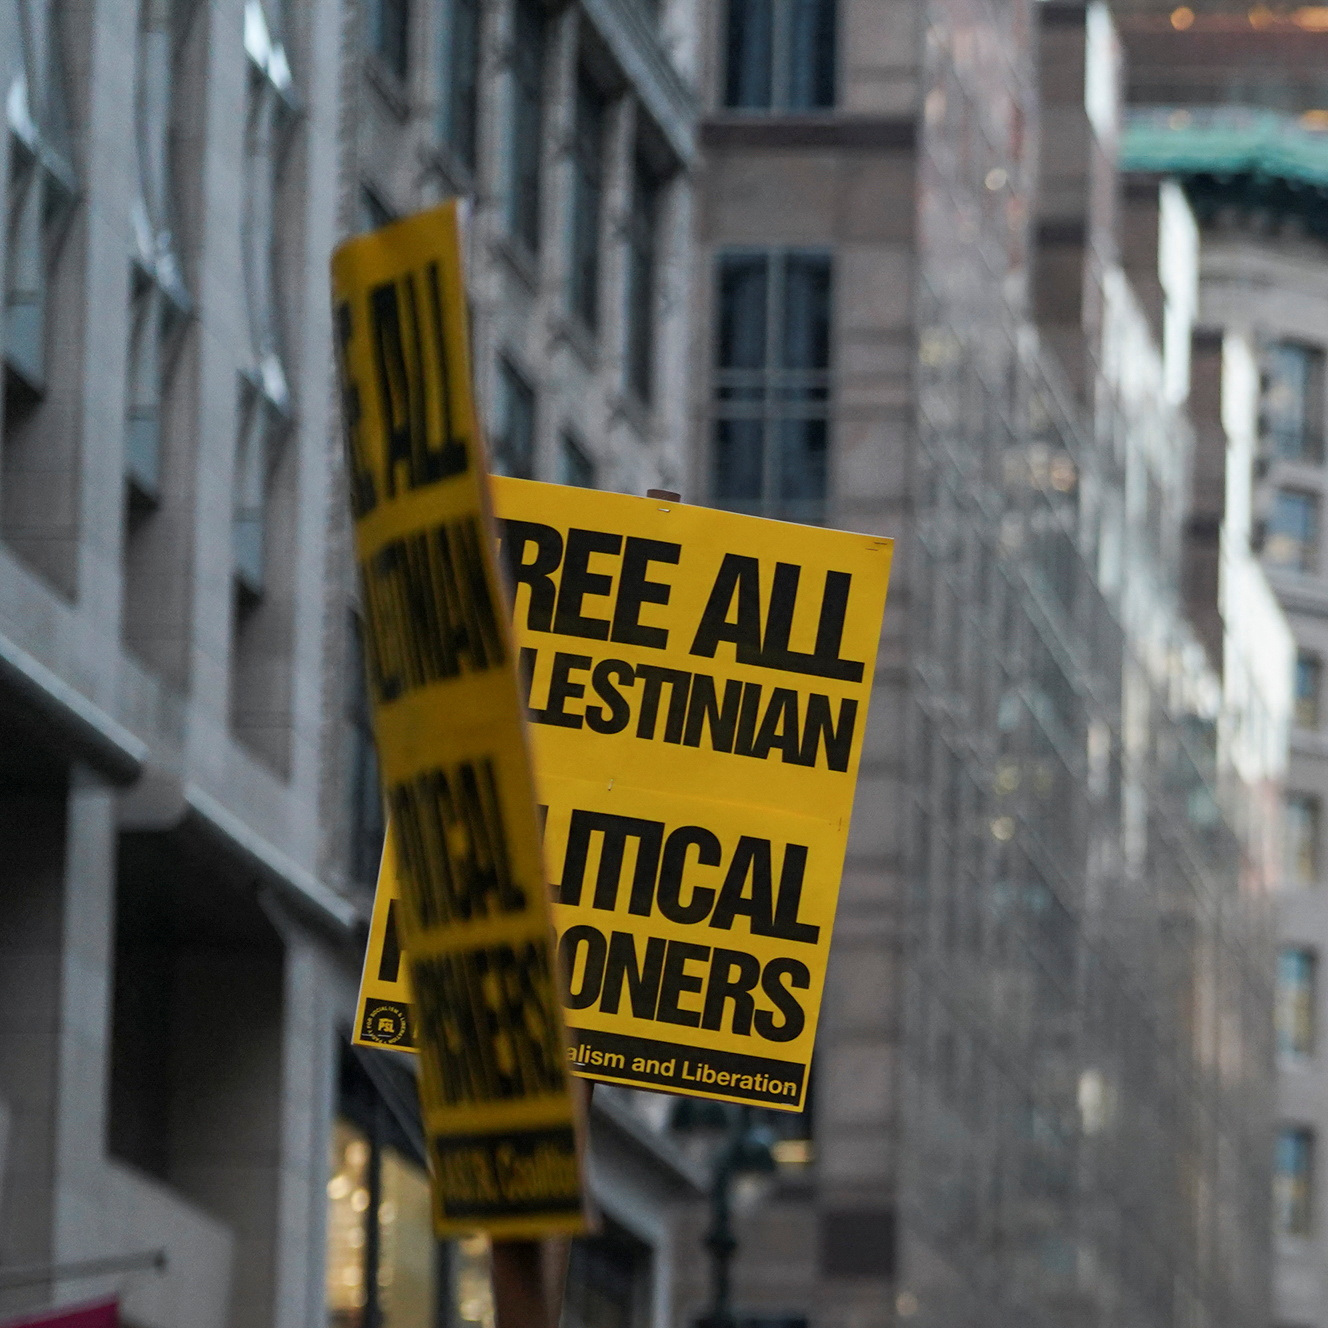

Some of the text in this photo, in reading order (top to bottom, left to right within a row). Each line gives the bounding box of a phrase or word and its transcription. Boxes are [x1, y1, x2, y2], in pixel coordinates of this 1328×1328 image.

[496, 517, 682, 650] REE
[689, 552, 866, 683] ALL
[518, 647, 858, 773] LESTINIAN
[538, 804, 820, 945] ITICAL
[556, 923, 811, 1043] ONERS
[566, 1043, 798, 1098] alism and Liberation
